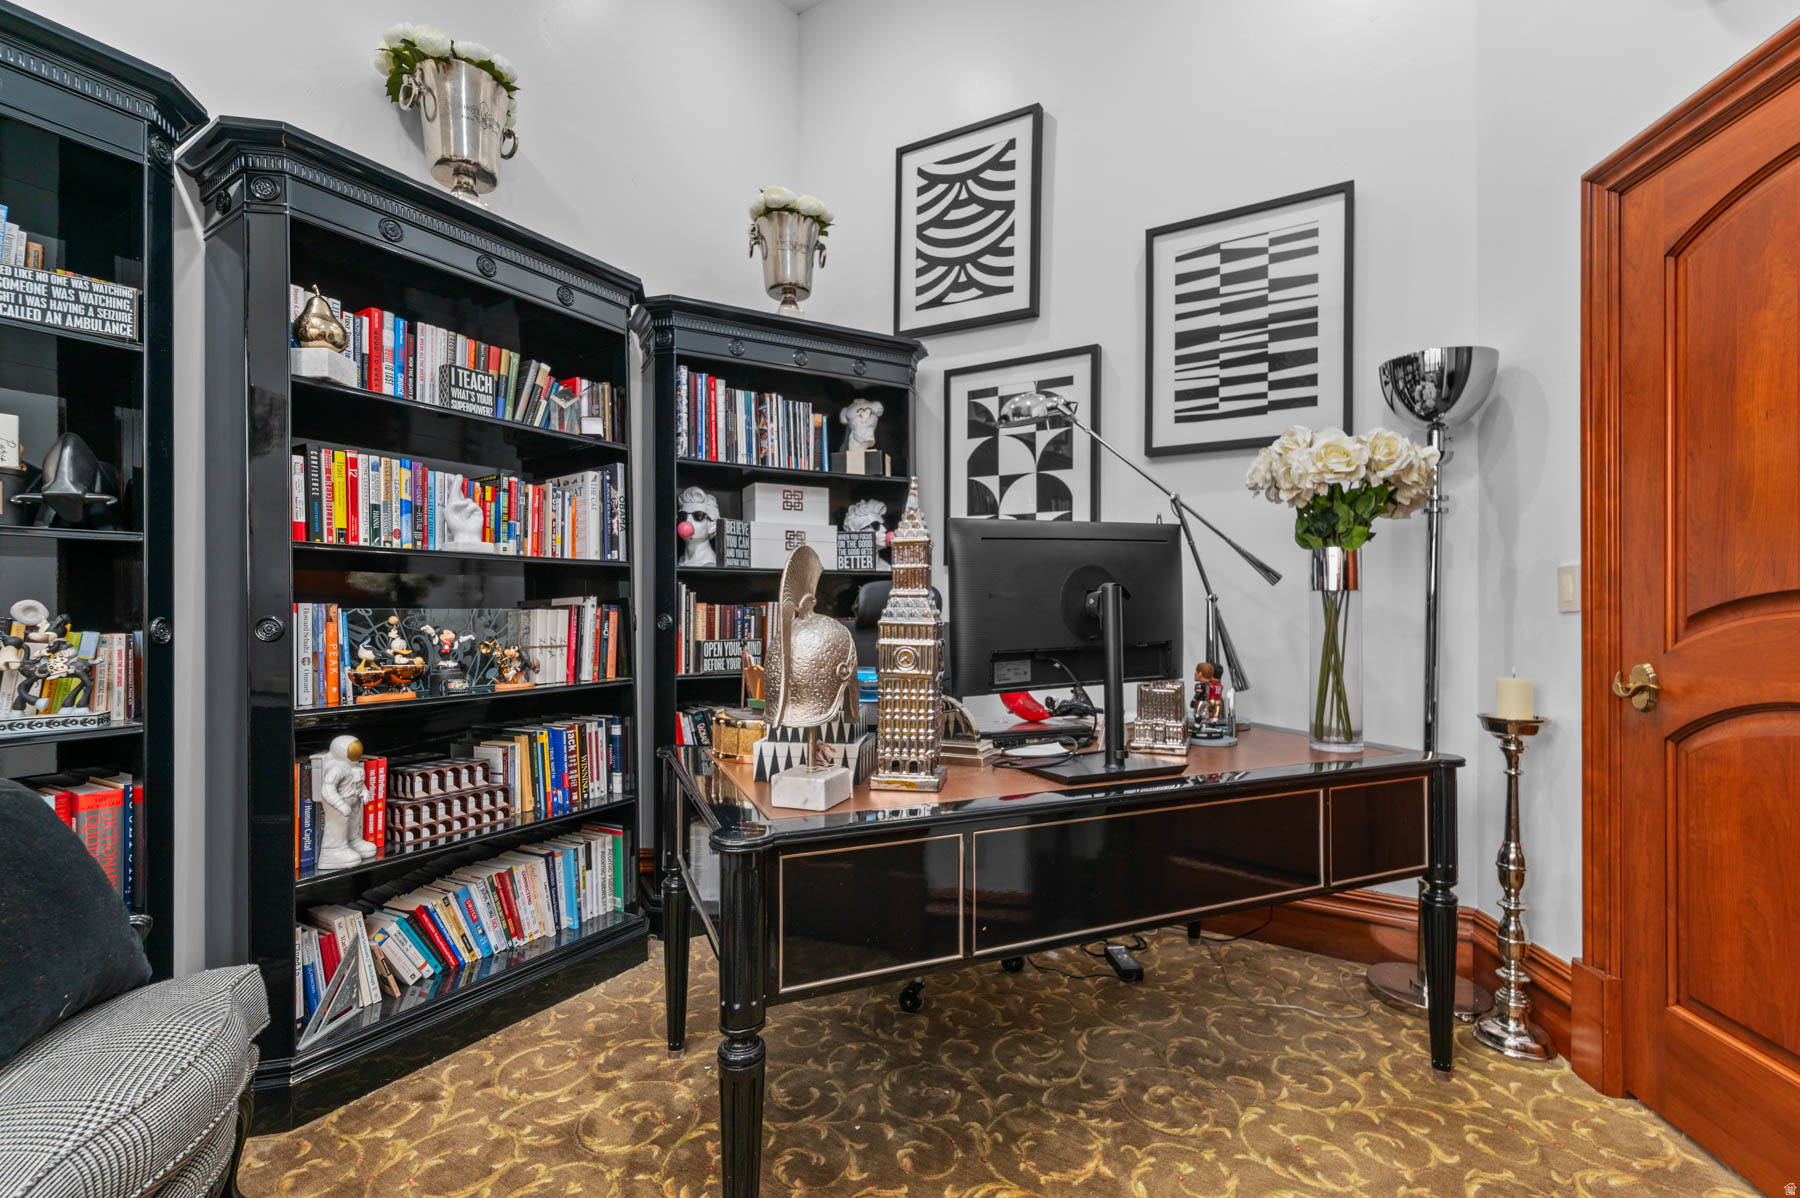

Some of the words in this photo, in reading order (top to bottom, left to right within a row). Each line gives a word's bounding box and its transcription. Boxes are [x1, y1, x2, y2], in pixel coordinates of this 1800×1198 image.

[15, 268, 33, 279] LIKE
[36, 271, 48, 282] NO
[51, 275, 68, 286] ONE
[71, 279, 89, 290] WAS
[92, 282, 133, 298] WATCHING
[0, 277, 47, 296] OMEONE
[52, 286, 75, 301] WAS
[79, 291, 132, 312] WATCHING.
[19, 294, 22, 304] I
[26, 295, 47, 308] WAS
[50, 299, 85, 315] HAVING
[88, 306, 94, 316] A
[97, 308, 133, 323] SEIZURE
[0, 303, 41, 321] CALLED
[45, 311, 62, 325] AN
[65, 314, 133, 337] AMBULANCE
[374, 355, 379, 364] TO
[385, 372, 394, 385] LAST
[451, 367, 455, 385] I
[457, 369, 492, 394] TEACH
[451, 387, 475, 402] WHAT'S
[477, 393, 492, 406] YOUR
[451, 400, 493, 416] SUPERPOWER?
[310, 451, 319, 496] CONFIDENCE
[349, 468, 358, 478] 12
[325, 474, 333, 529] CREDIBILITY
[726, 520, 749, 536] BELIEVE
[738, 536, 749, 549] CAN
[838, 540, 845, 548] ON
[846, 540, 857, 548] THE
[858, 540, 872, 548] GOOD
[838, 556, 873, 569] BETTER
[329, 643, 338, 674] PEAK
[704, 641, 722, 657] OPEN
[724, 641, 741, 656] YOUR
[704, 658, 725, 671] BEFORE
[726, 657, 741, 670] YOUR
[566, 730, 576, 751] jack
[580, 755, 588, 793] WINNING
[304, 805, 312, 827] Human
[303, 829, 312, 851] Capital
[521, 871, 532, 905] CONNECTING
[465, 899, 477, 922] SWITCH
